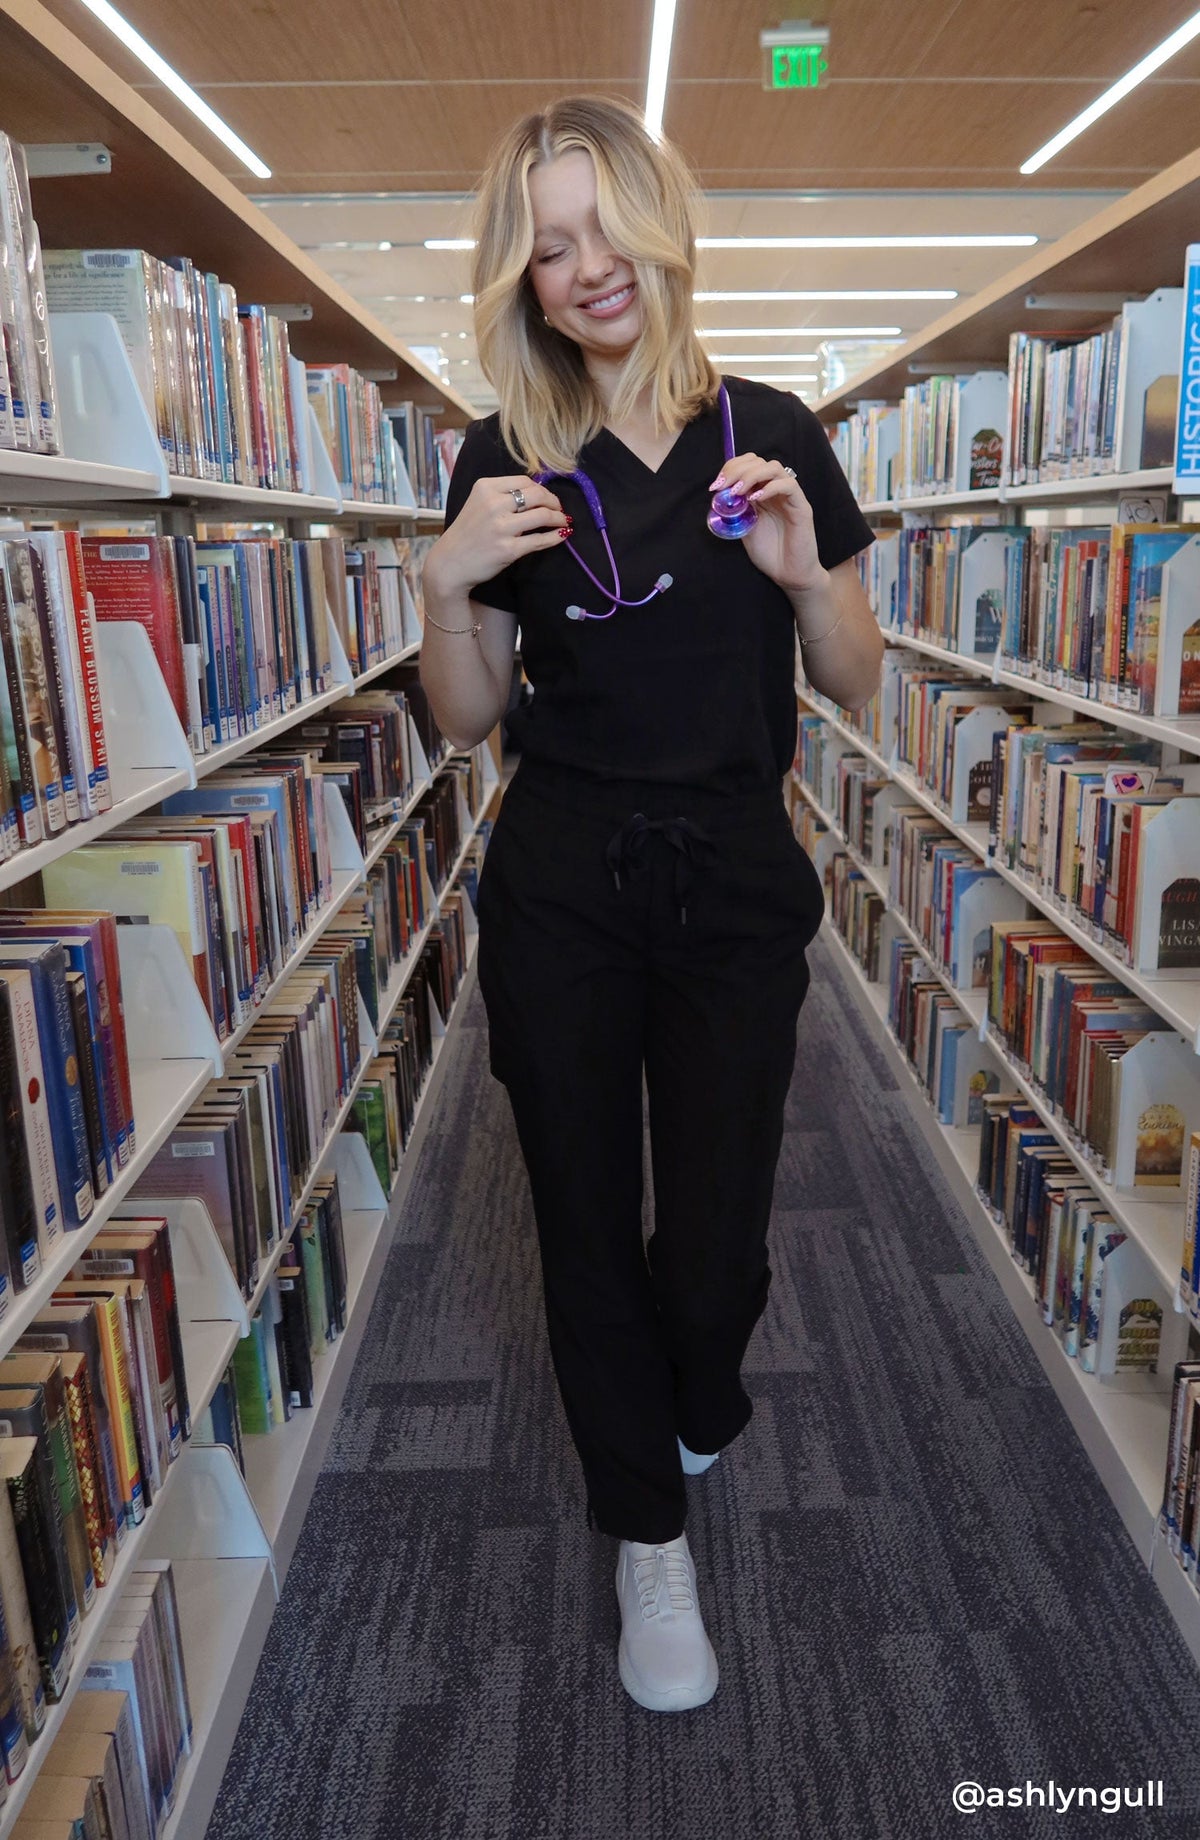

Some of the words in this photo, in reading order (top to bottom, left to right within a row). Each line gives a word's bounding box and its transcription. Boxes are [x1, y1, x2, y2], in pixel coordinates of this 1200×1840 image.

[773, 46, 822, 88] EXIT
[1181, 290, 1200, 476] HISTORI
[79, 609, 95, 654] PEACH
[86, 661, 103, 724] BLOSSOM
[24, 1001, 35, 1050] DIANA
[59, 983, 71, 1031] DIANA
[14, 991, 31, 1073] GABALDON
